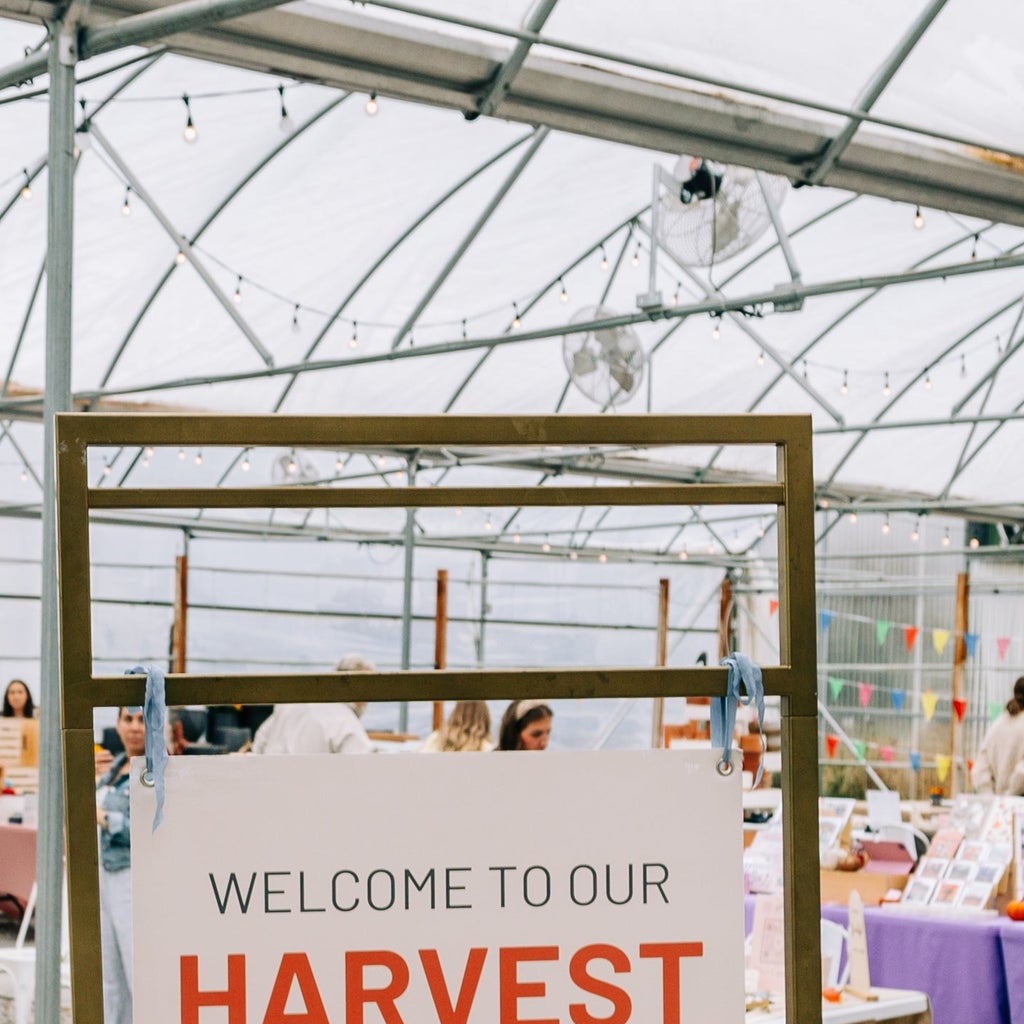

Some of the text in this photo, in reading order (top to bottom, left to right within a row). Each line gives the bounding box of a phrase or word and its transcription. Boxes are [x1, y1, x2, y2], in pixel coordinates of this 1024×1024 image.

[209, 863, 669, 914] WELCOME TO OUR
